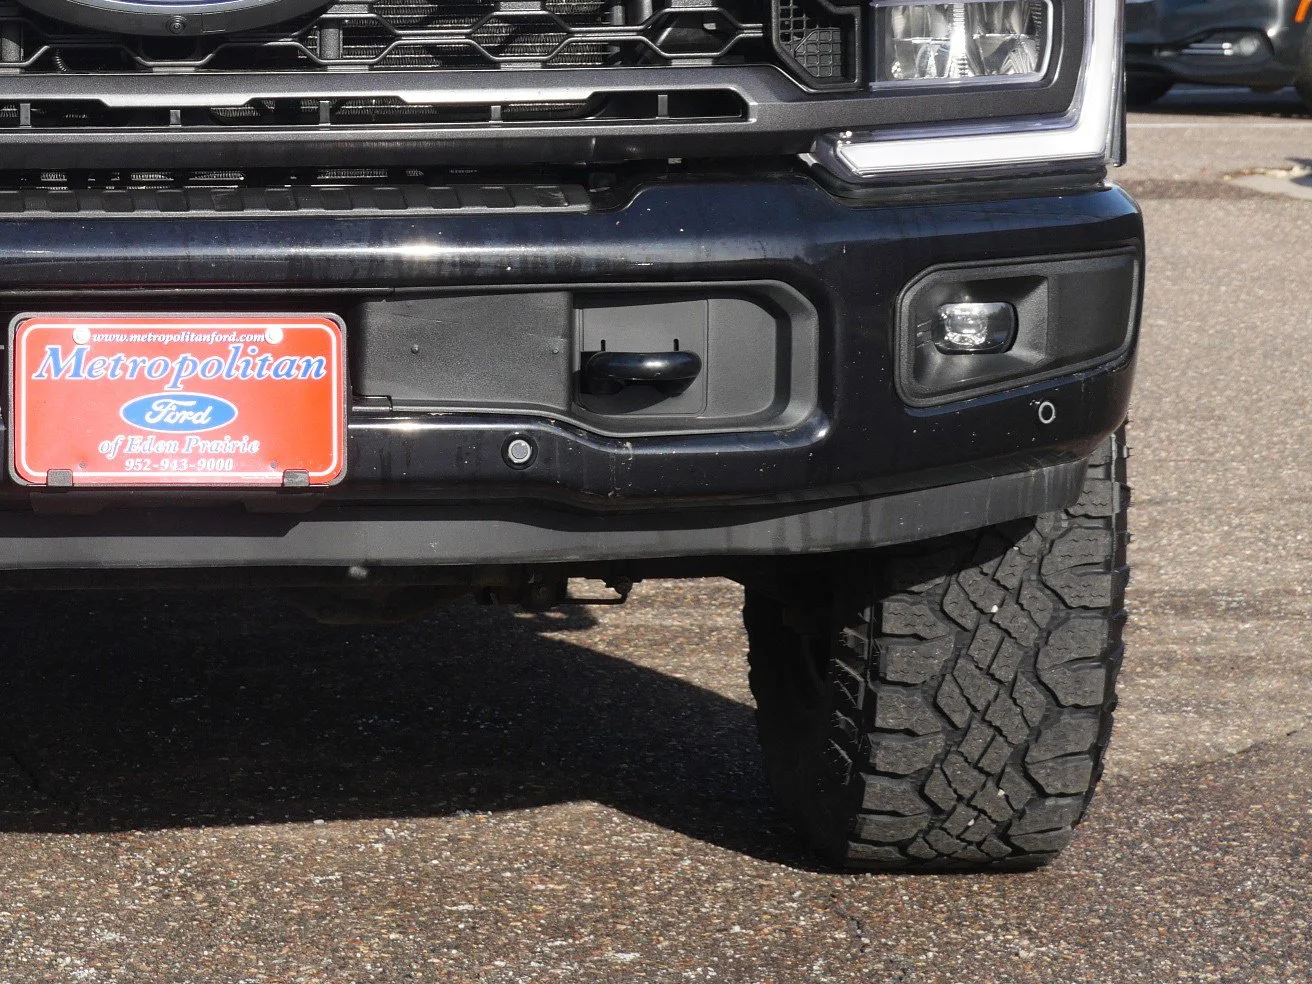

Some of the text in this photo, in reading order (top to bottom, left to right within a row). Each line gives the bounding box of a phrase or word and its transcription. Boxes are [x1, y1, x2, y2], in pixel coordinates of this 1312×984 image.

[93, 331, 266, 345] www.metropolitanford.com
[32, 344, 328, 391] Metropolitan
[144, 398, 213, 425] Ford
[98, 434, 261, 460] of Eden Prairie
[124, 457, 235, 472] 952-943-9000
